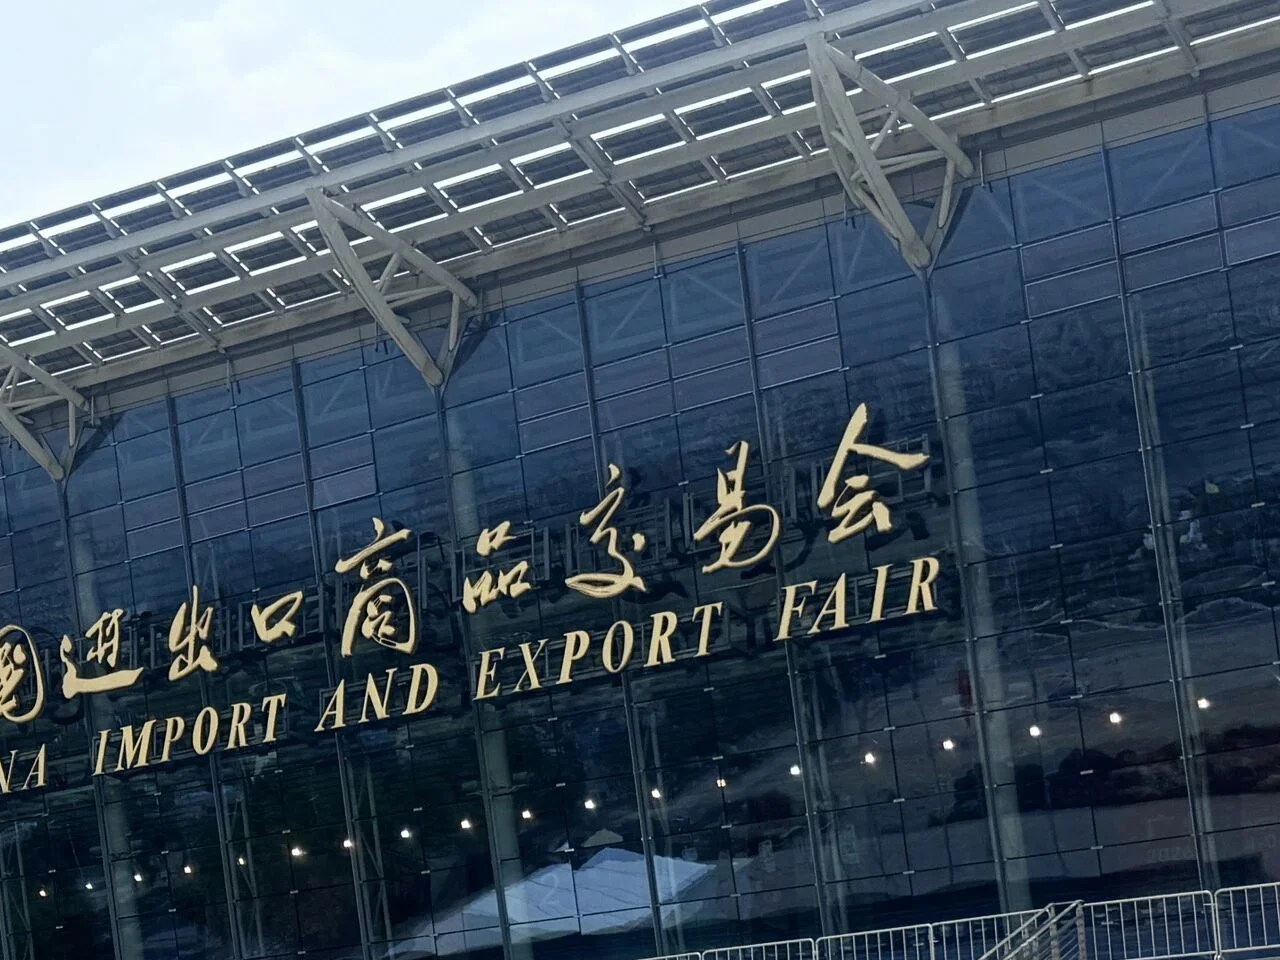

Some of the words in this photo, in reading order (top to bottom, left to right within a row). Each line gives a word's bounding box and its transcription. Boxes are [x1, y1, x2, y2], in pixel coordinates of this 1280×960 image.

[91, 693, 287, 776] IMPORT
[313, 662, 439, 733] AND
[472, 601, 724, 701] EXPORT
[775, 556, 940, 641] FAIR
